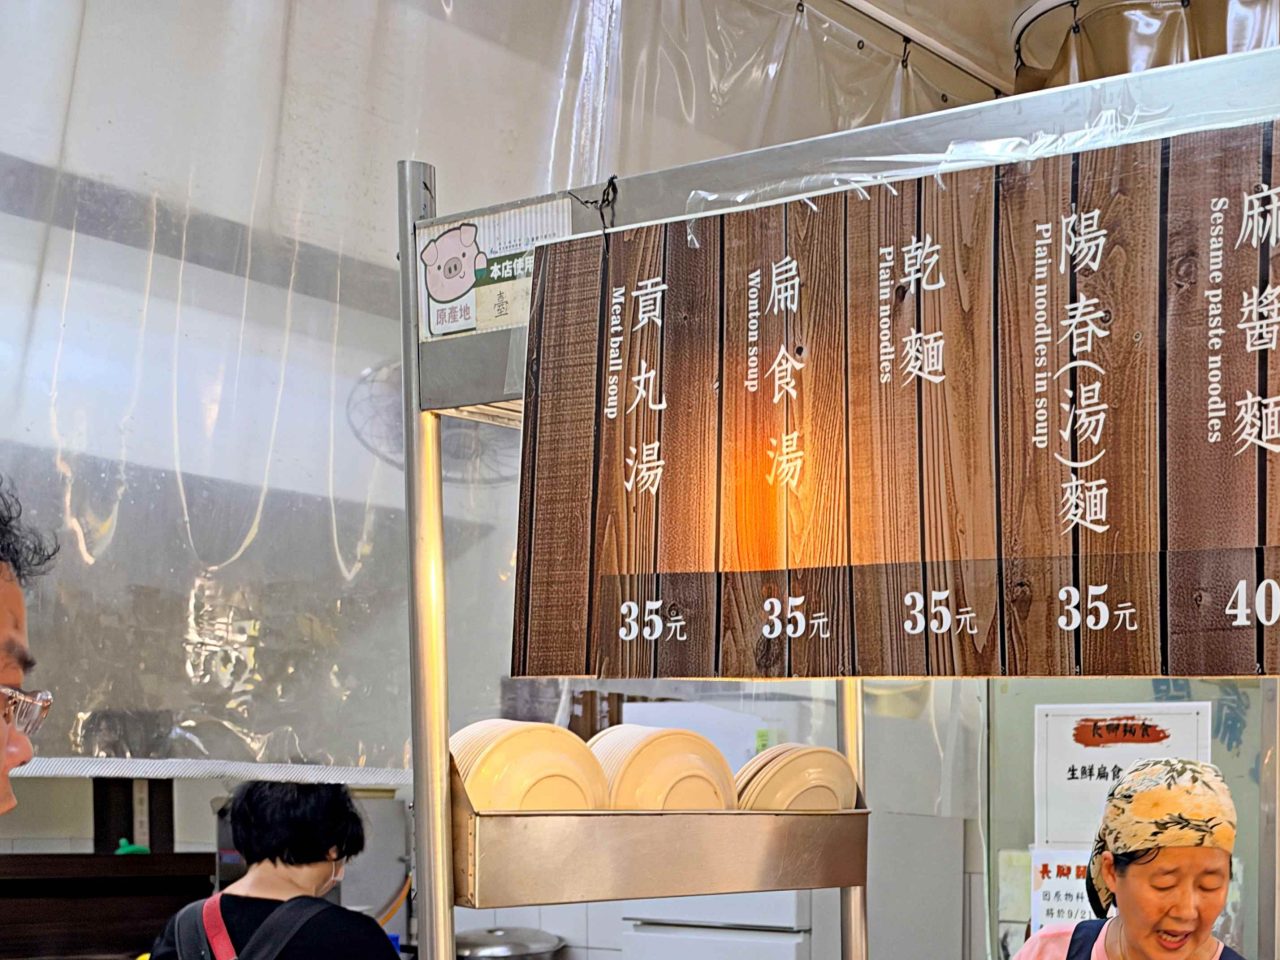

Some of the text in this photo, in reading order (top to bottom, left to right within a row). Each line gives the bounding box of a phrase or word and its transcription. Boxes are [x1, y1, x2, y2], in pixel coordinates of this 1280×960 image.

[435, 305, 472, 326] 原產地
[490, 255, 534, 281] 本店使用
[743, 268, 761, 393] Wonton soup
[879, 245, 895, 385] Plain noodles
[899, 234, 947, 388] 乾麵
[1204, 196, 1230, 444] Sesame paste noodles
[604, 285, 626, 420] Meat ball soup
[624, 275, 669, 496] 貢丸湯
[764, 254, 806, 488] 扁食湯
[1031, 222, 1052, 449] Plain noodles in soup
[1053, 208, 1111, 536] 陽春(湯)麵
[618, 599, 687, 642] 35元
[761, 595, 831, 640] 35元
[903, 589, 978, 636] 35元
[1057, 583, 1138, 632] 35元
[1066, 764, 1123, 781] 生鮮扁食
